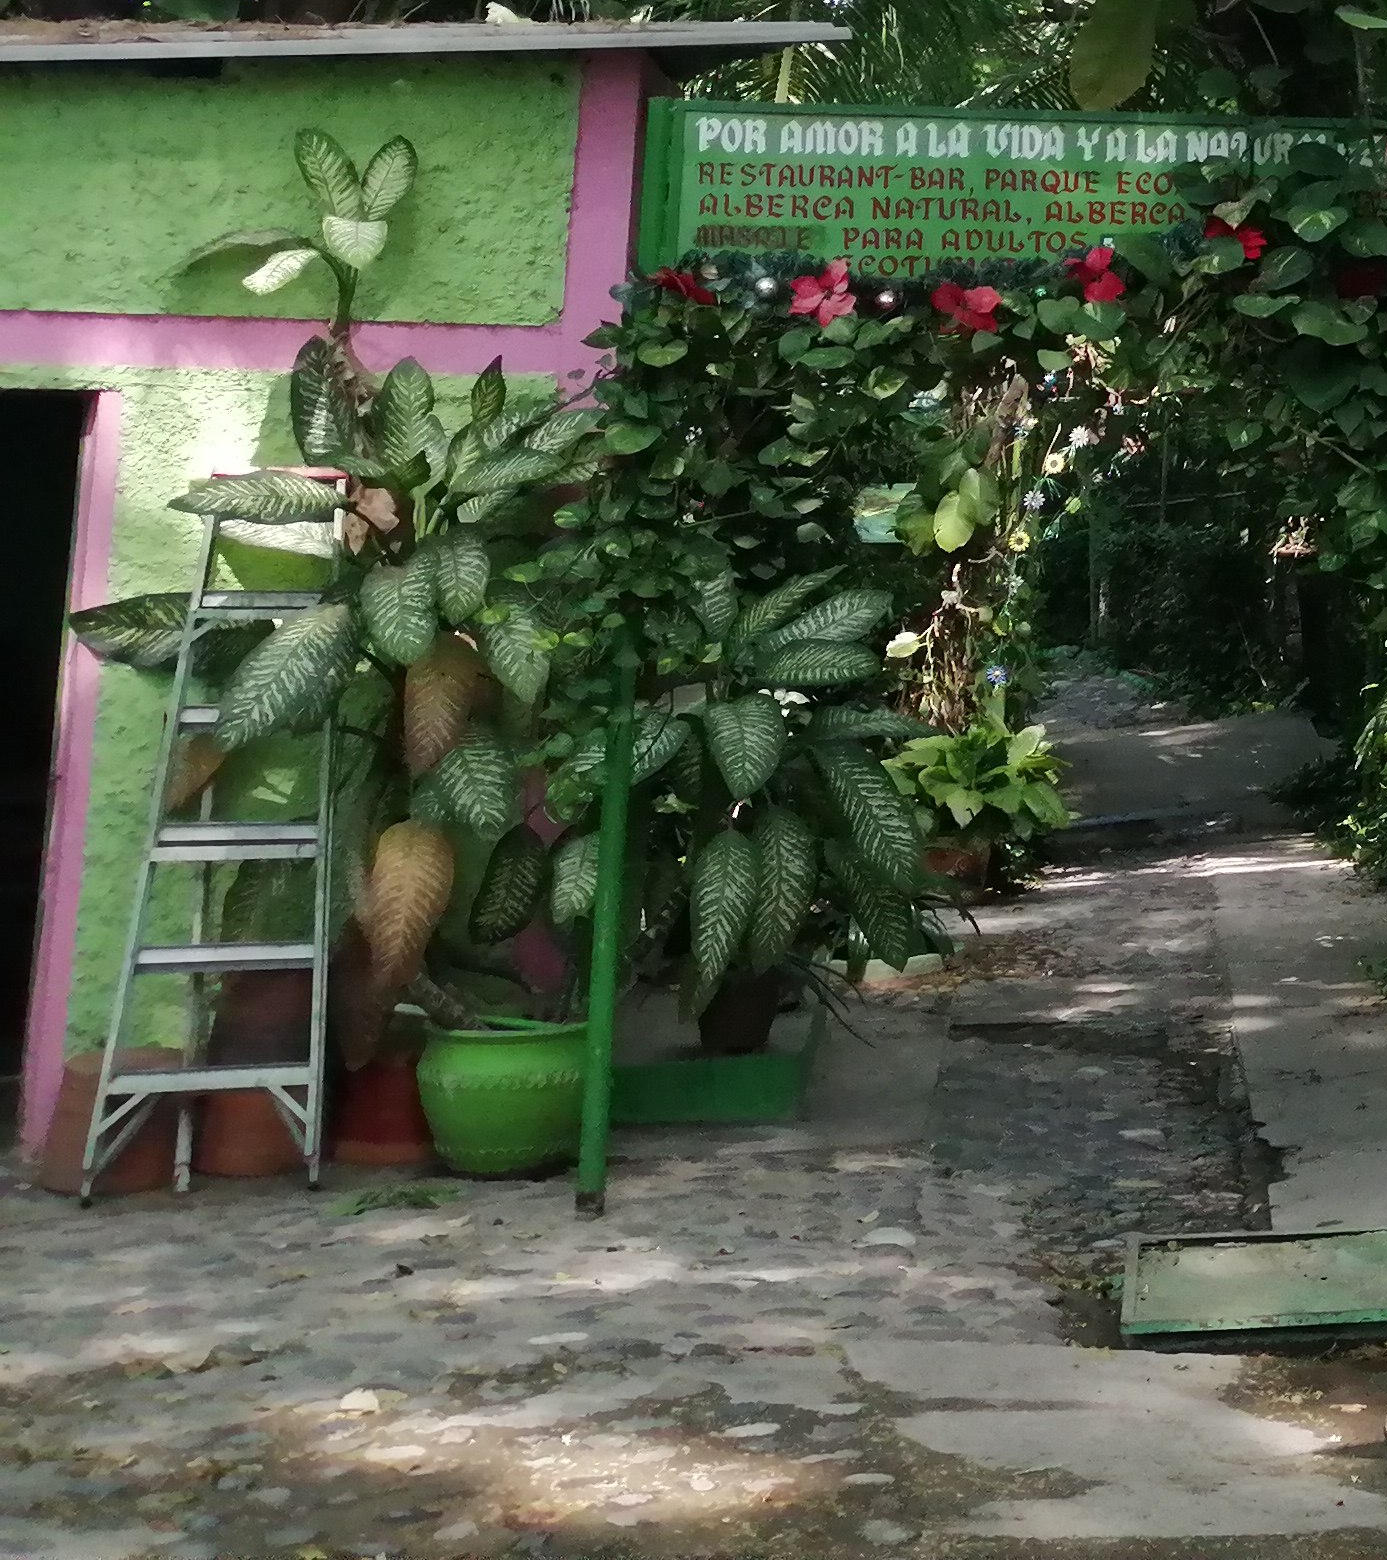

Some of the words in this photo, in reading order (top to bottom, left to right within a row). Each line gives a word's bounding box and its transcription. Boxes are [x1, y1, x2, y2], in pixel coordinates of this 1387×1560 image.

[695, 116, 768, 155] POR
[779, 118, 885, 157] AMOR
[895, 120, 919, 158] A
[924, 122, 972, 159] LA
[981, 122, 1067, 161] VIDA
[1076, 125, 1102, 162] Y
[1104, 127, 1128, 163] A
[1134, 128, 1178, 164] LA
[984, 167, 1100, 195] PARQUE
[698, 193, 855, 221] ALBERCA
[1044, 199, 1186, 226] ALBERCA
[841, 227, 924, 252] PARA
[940, 229, 1090, 254] ADULTOS
